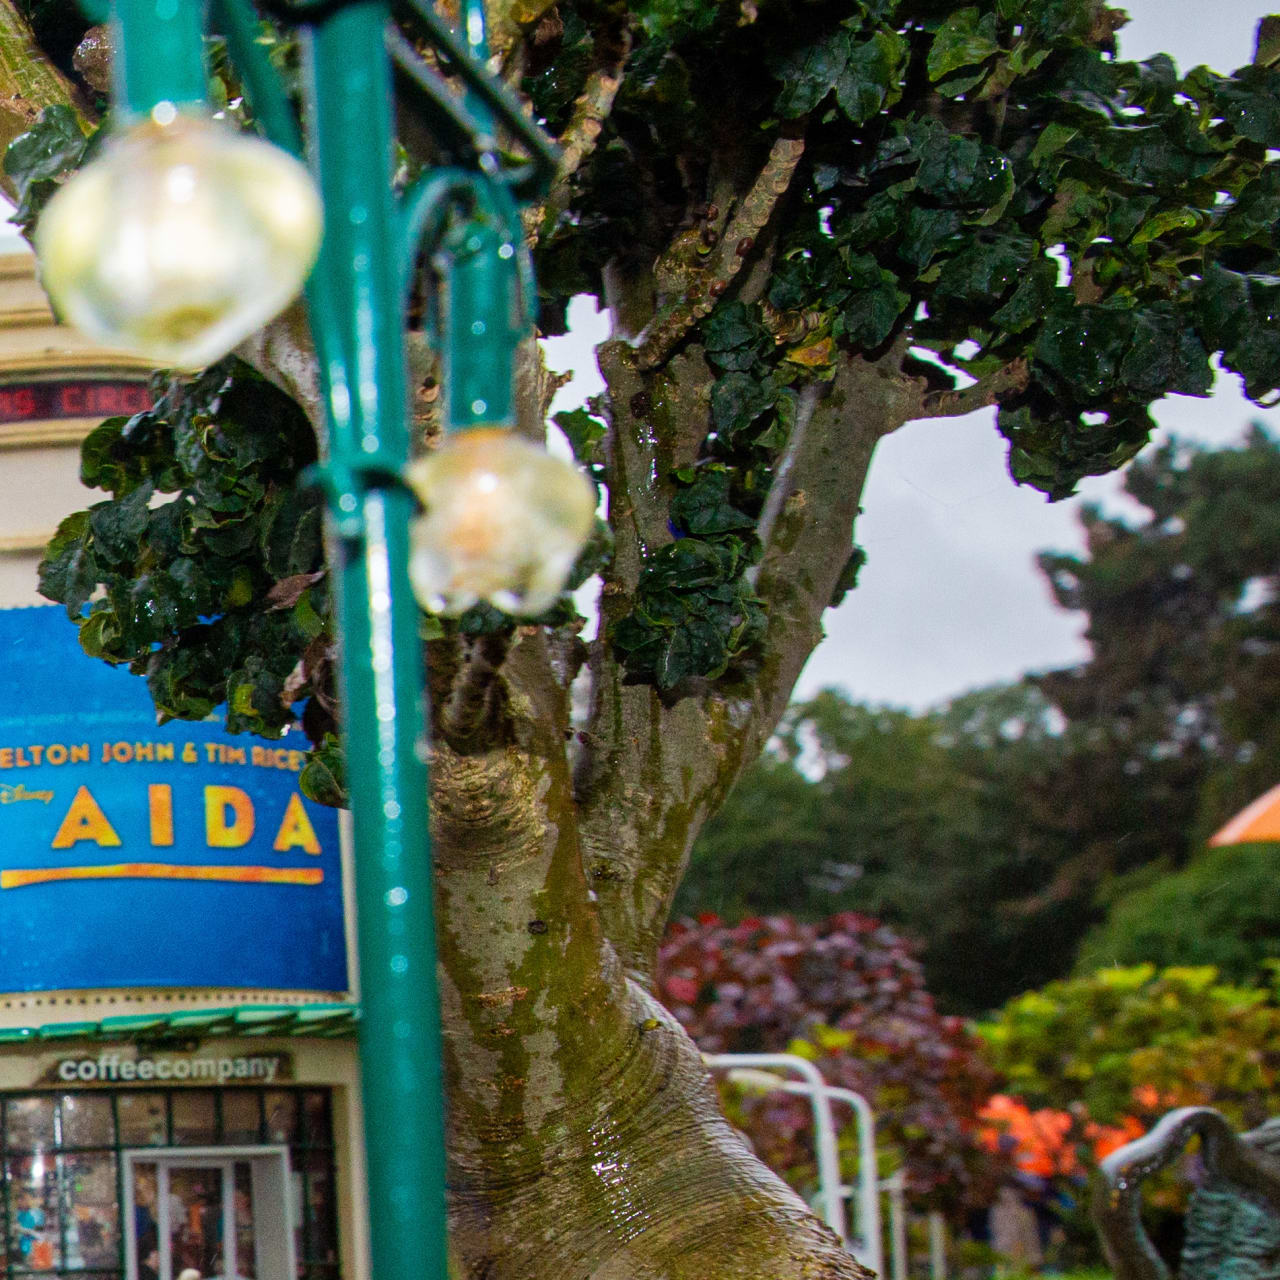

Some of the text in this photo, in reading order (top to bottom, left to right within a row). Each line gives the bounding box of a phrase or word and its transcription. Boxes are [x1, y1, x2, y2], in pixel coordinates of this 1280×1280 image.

[102, 742, 174, 763] JOHN
[182, 743, 198, 763] &
[205, 743, 246, 765] TIM
[50, 784, 323, 856] AIDA
[59, 1055, 278, 1084] coffeecompany
